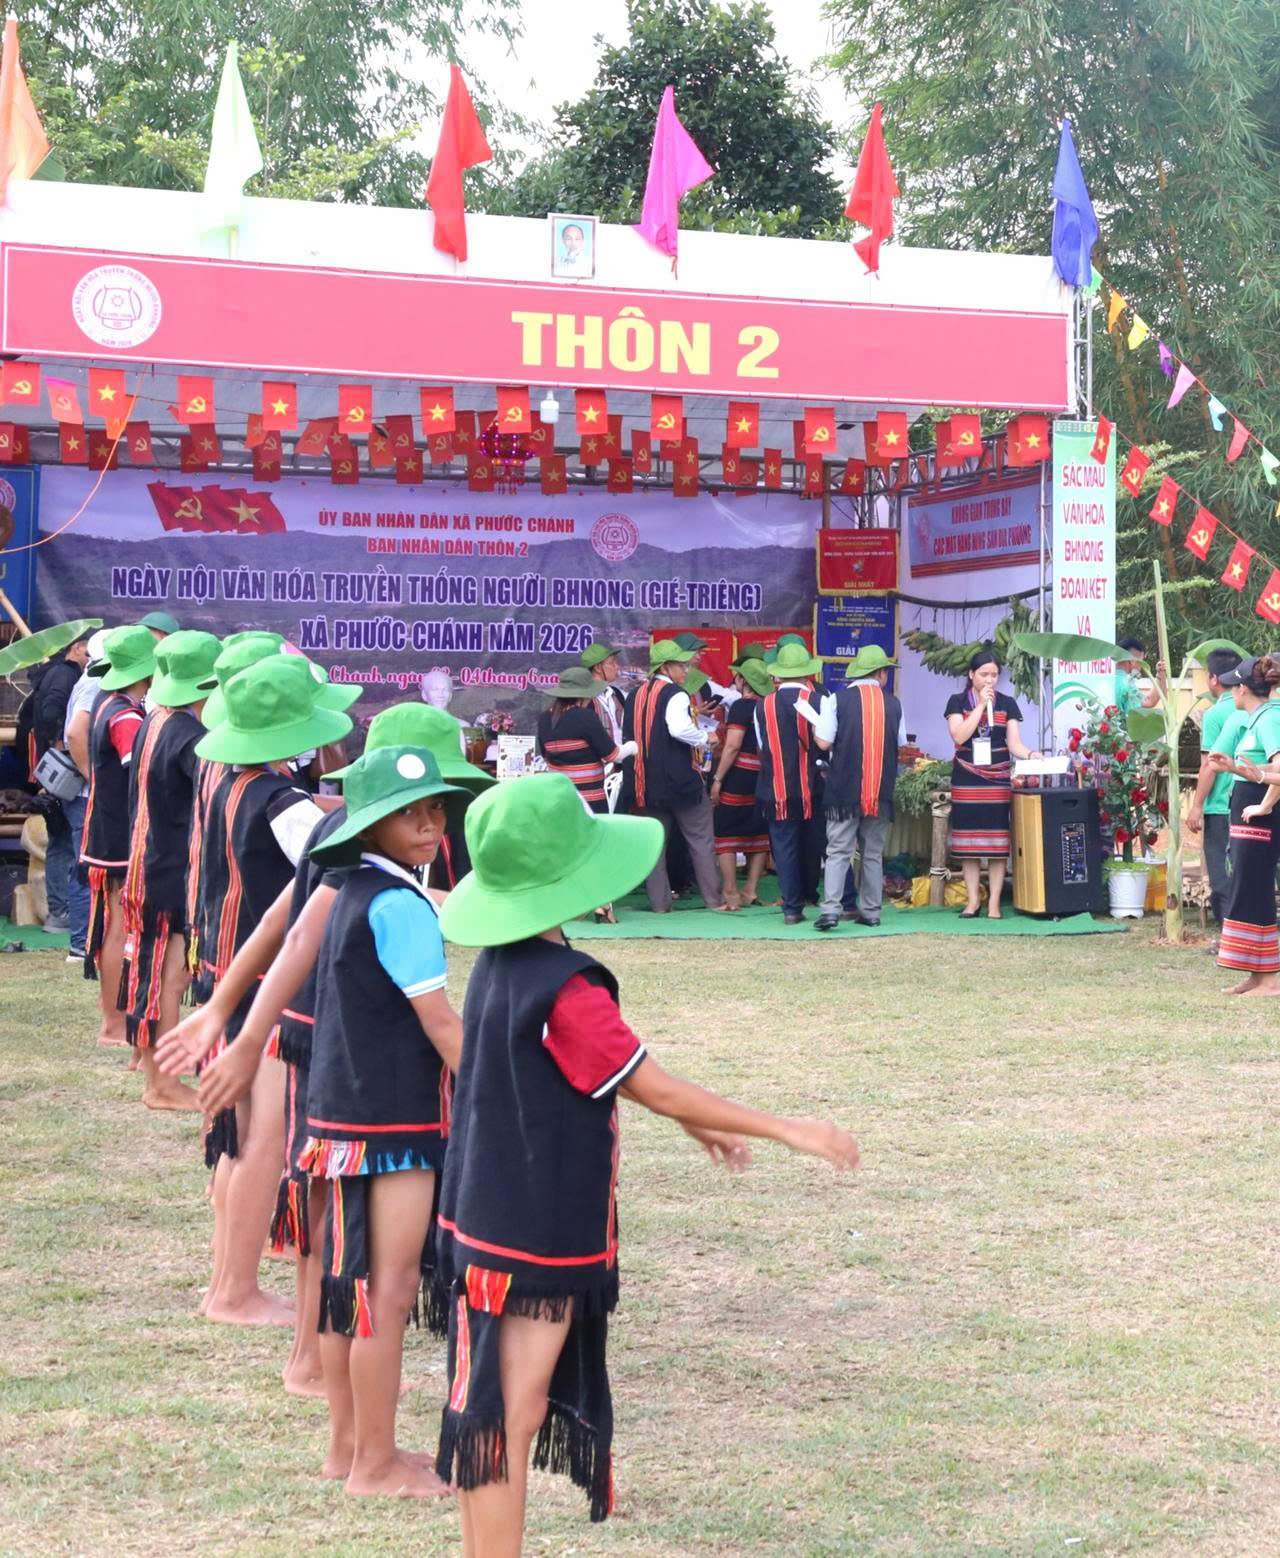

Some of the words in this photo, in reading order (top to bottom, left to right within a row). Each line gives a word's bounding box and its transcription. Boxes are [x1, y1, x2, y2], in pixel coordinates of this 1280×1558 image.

[511, 306, 711, 375] THÔN
[736, 325, 780, 378] 2
[342, 513, 371, 528] BAN
[376, 511, 415, 529] NHÂN
[420, 512, 448, 530] DÂN
[453, 513, 471, 530] XÃ
[475, 513, 523, 533] PHƯỚC
[527, 516, 575, 534] CHÁNH
[367, 537, 396, 553] BAN
[401, 537, 440, 554] NHÂN
[444, 537, 473, 556] DÂN
[478, 539, 515, 557] THÔN
[519, 542, 528, 557] 2
[1064, 540, 1104, 562] BHNONG
[112, 564, 171, 599] NGÀY
[177, 565, 217, 605] HỘI
[221, 566, 267, 601] VĂN
[272, 567, 317, 602] HÓA
[322, 564, 401, 603] TRUYỀN
[407, 566, 478, 605] THỐNG
[482, 572, 548, 607] NGƯỜI
[552, 577, 635, 609] BHNONG
[640, 578, 762, 612] (GIÉ-TRIÊNG)
[300, 616, 329, 649] XÃ
[333, 616, 406, 651] PHƯỚC
[411, 617, 483, 652] CHÁNH
[488, 618, 536, 653] NĂM
[539, 623, 594, 654] 2026
